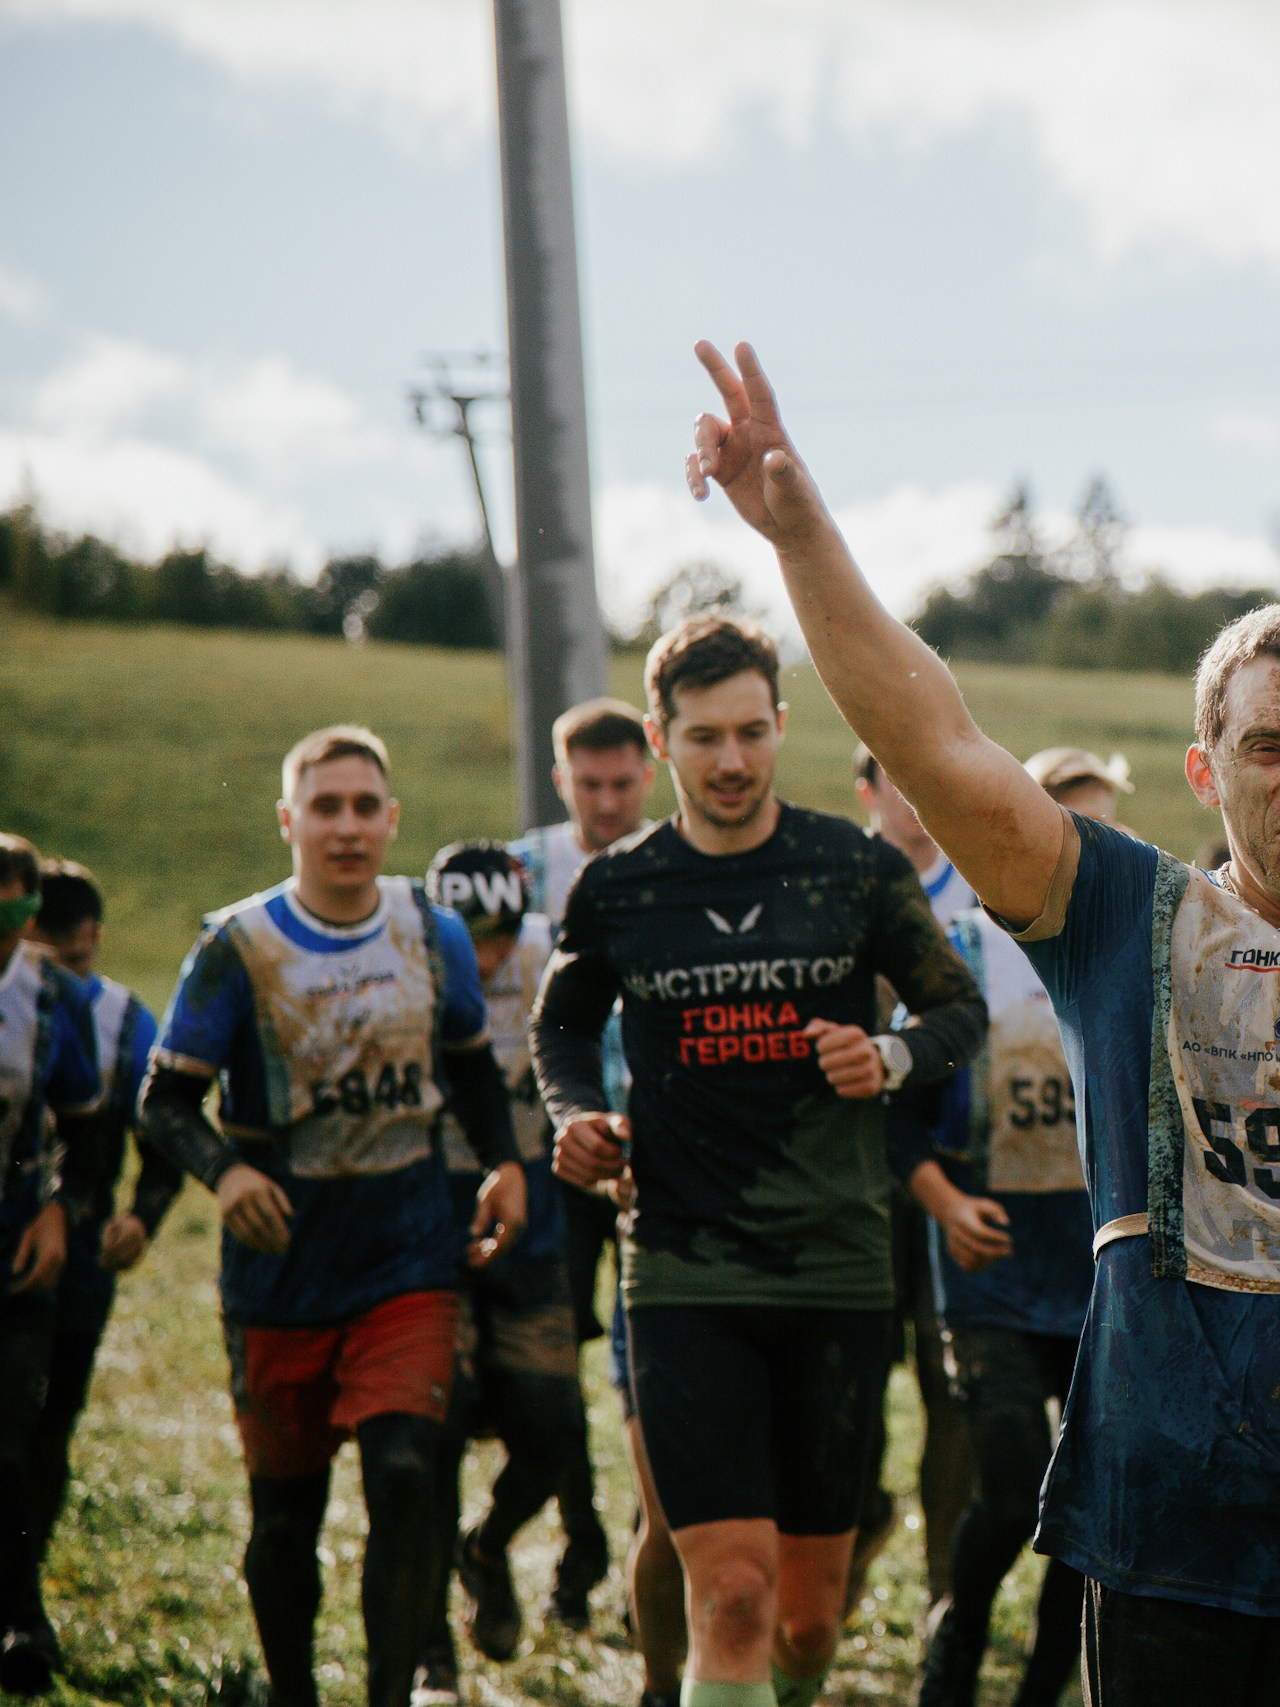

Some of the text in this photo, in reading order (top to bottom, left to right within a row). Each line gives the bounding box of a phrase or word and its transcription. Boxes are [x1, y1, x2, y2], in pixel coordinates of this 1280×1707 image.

[441, 871, 523, 915] PW
[682, 1000, 799, 1034] ГОНКА
[1182, 1040, 1201, 1052] АО
[1204, 1046, 1237, 1060] «ВПК
[1240, 1048, 1273, 1062] «НПО
